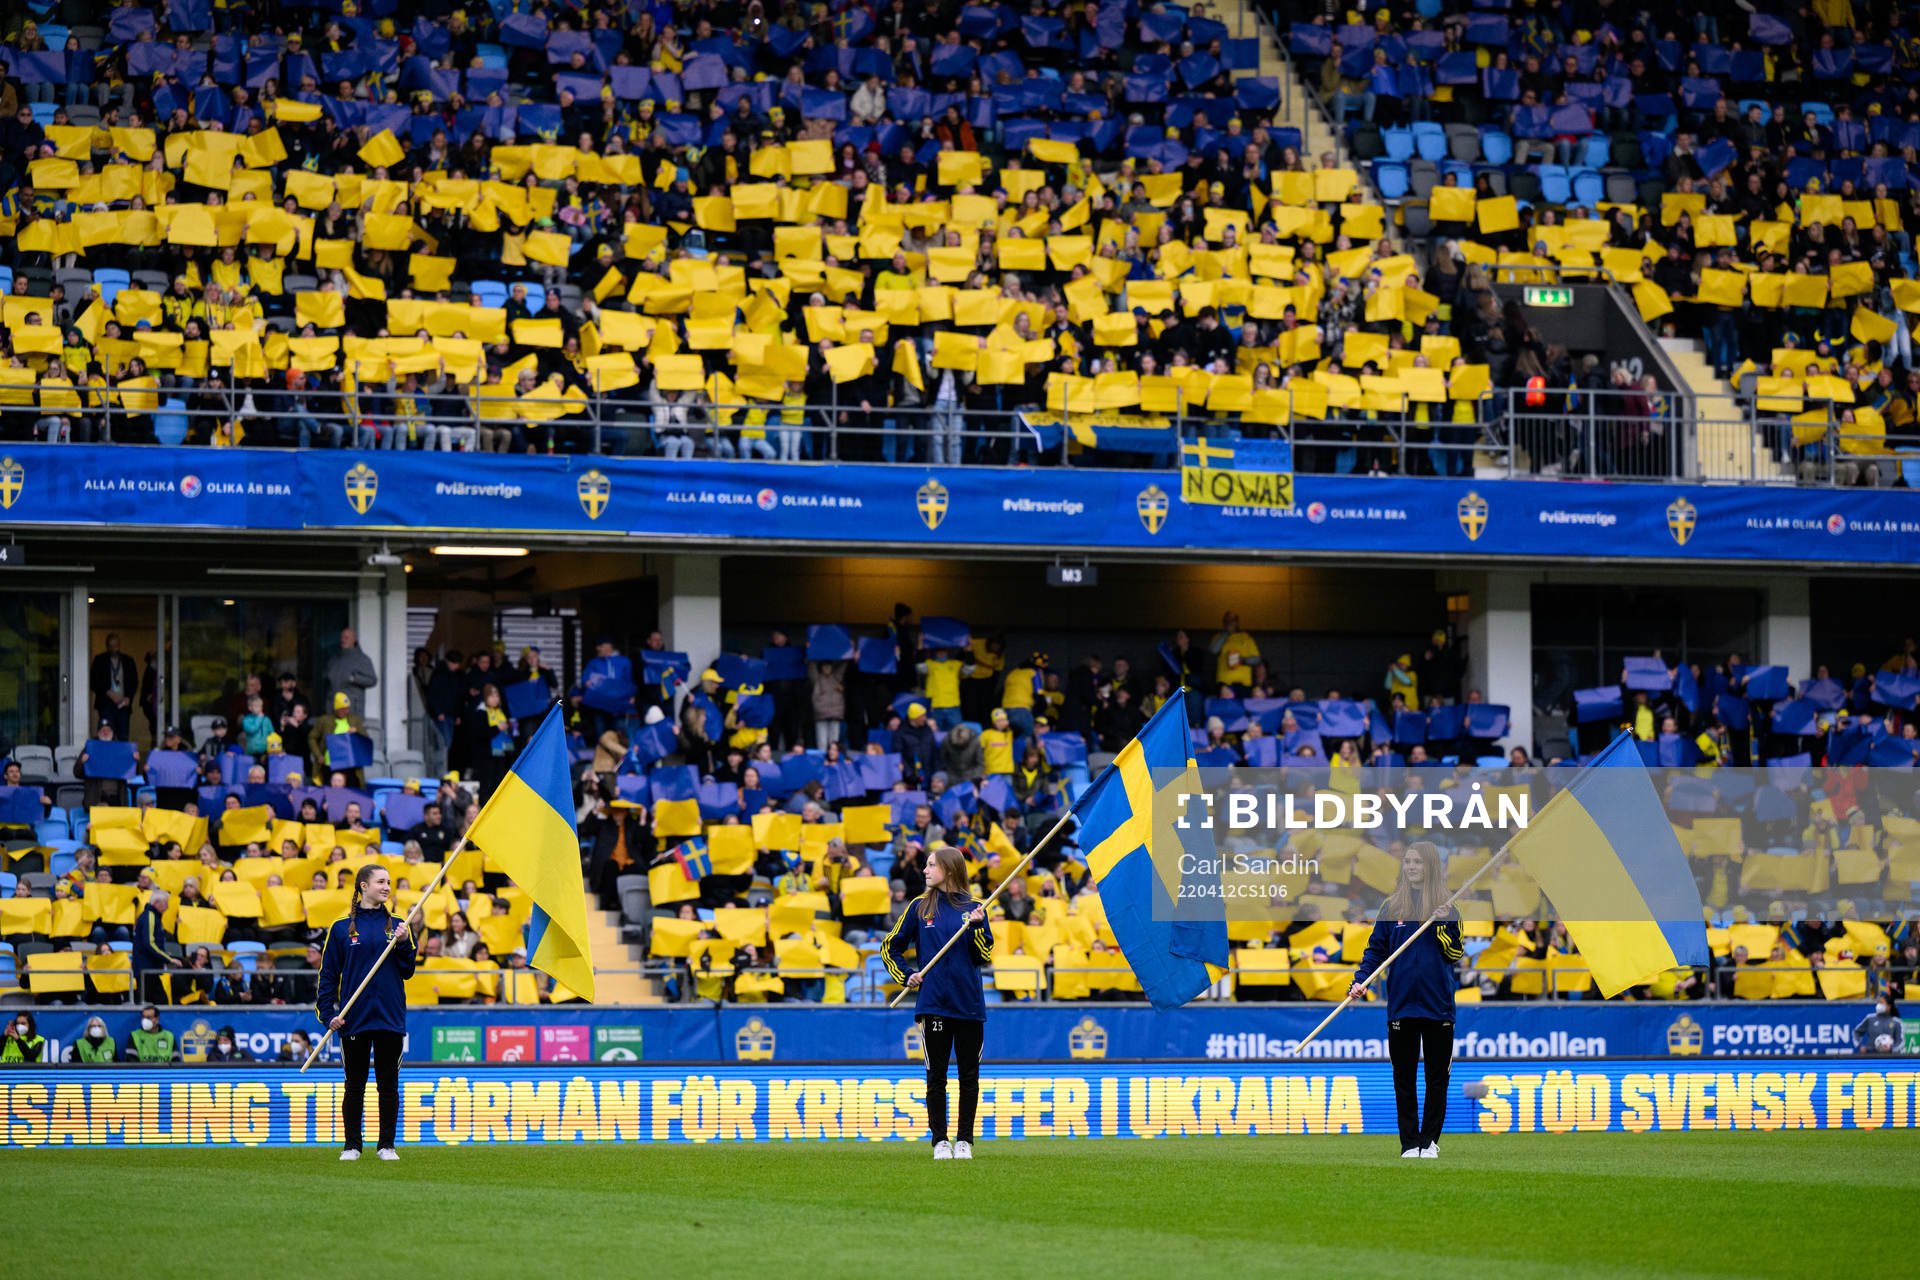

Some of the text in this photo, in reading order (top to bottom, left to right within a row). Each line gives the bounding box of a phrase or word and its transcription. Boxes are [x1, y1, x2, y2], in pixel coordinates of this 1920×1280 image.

[84, 479, 115, 490] ALLA
[138, 480, 175, 492] OLIKA
[206, 482, 244, 494] OLIKA
[267, 484, 291, 495] BRA
[435, 481, 522, 499] #viärsverige
[666, 492, 697, 503] ALLA
[717, 493, 753, 505] OLIKA
[781, 495, 818, 507] OLIKA
[839, 497, 863, 508] BRA
[1330, 508, 1365, 519] OLIKA
[1384, 509, 1407, 520] BRA
[1746, 518, 1773, 529] ALLA
[1792, 519, 1823, 530] OLIKA
[1849, 520, 1881, 531] OLIKA
[1900, 522, 1920, 532] BRA
[1061, 568, 1083, 583] M3
[932, 1021, 943, 1032] 25
[1713, 1024, 1850, 1045] FOTBOLLEN
[1478, 1069, 1920, 1135] STÖD SVENSK FOT
[0, 1082, 271, 1148] SAMLING
[403, 1076, 641, 1146] FÖRMÅN
[651, 1075, 757, 1144] FÖR
[1100, 1077, 1119, 1136] I
[1128, 1076, 1364, 1139] UKRAINA
